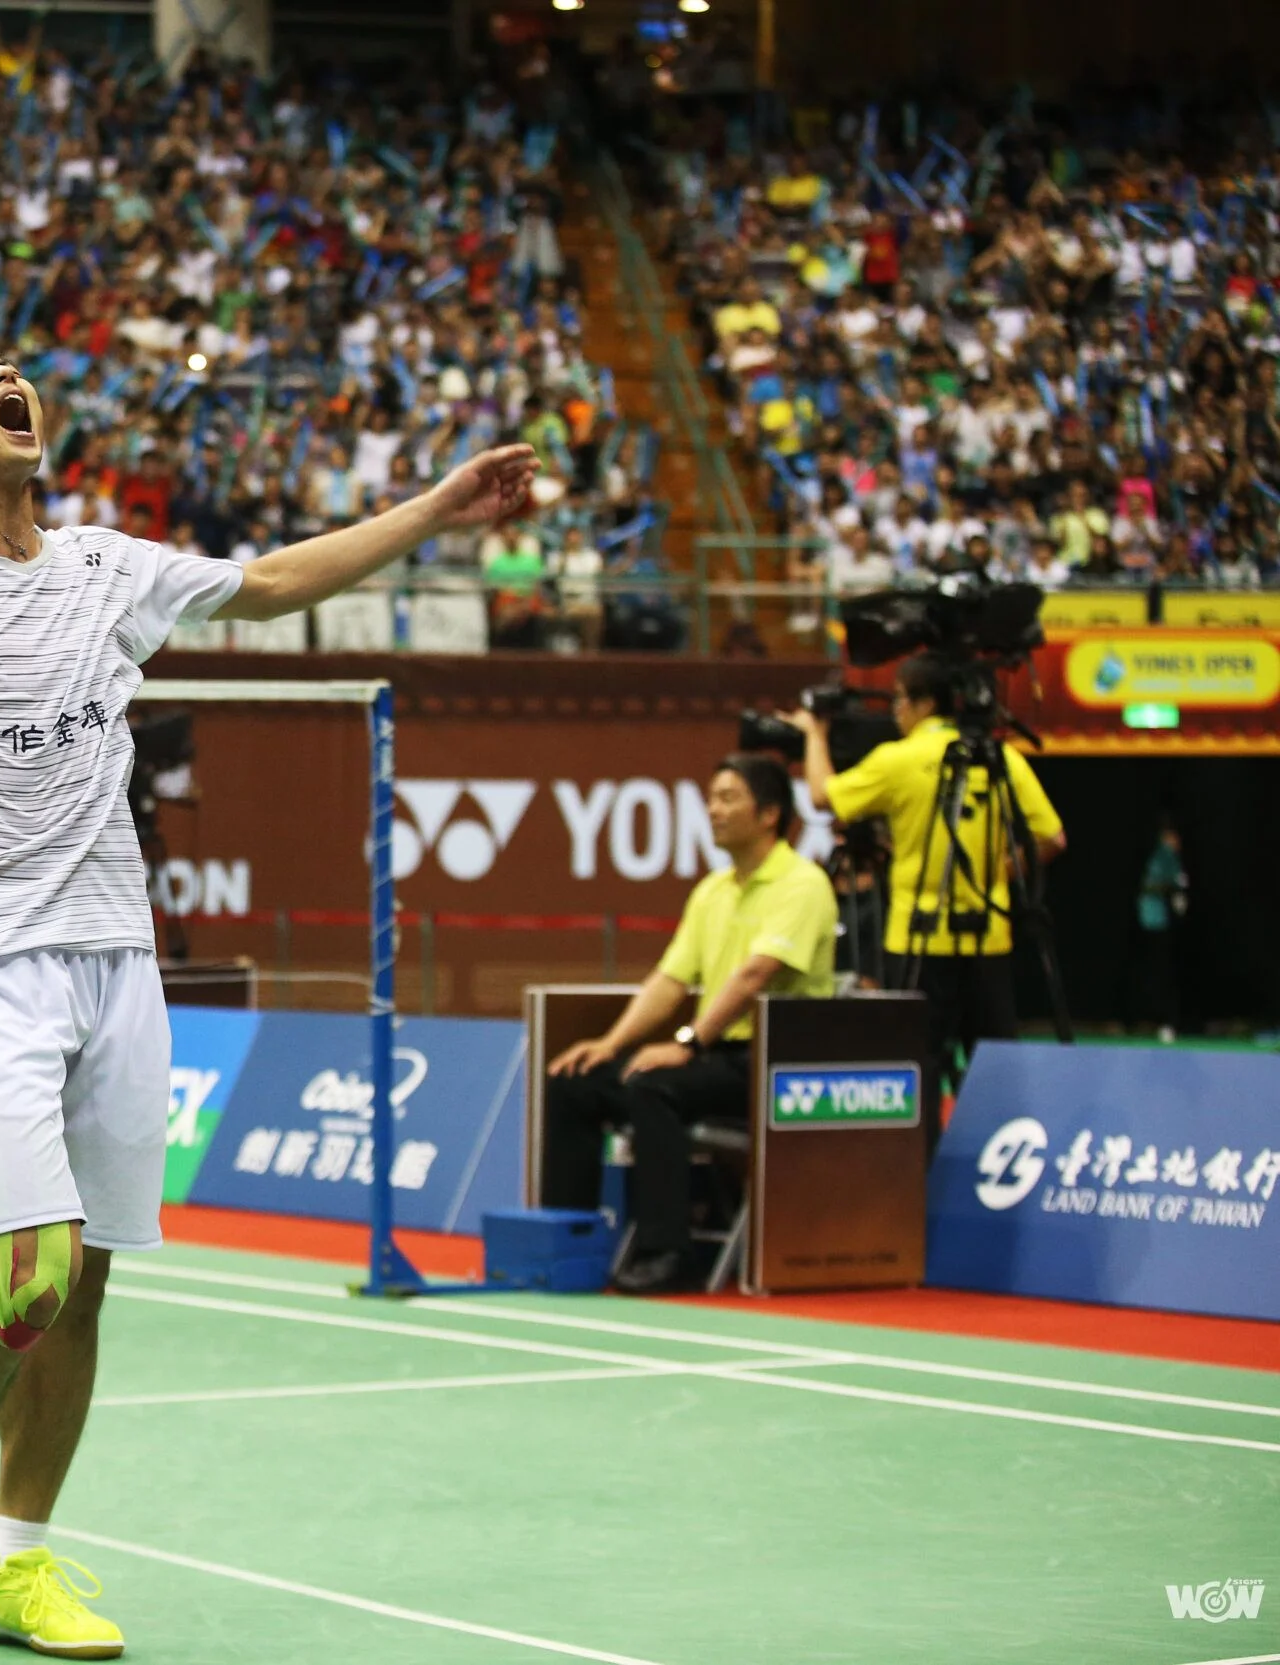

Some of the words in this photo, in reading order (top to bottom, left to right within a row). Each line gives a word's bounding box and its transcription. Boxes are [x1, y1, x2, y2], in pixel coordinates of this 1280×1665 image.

[552, 776, 837, 881] YONX
[829, 1078, 907, 1113] YONEX
[1040, 1185, 1097, 1215] LAND
[1097, 1189, 1155, 1221] BANK
[1156, 1194, 1189, 1224] OF
[1189, 1197, 1266, 1229] TAIWAN
